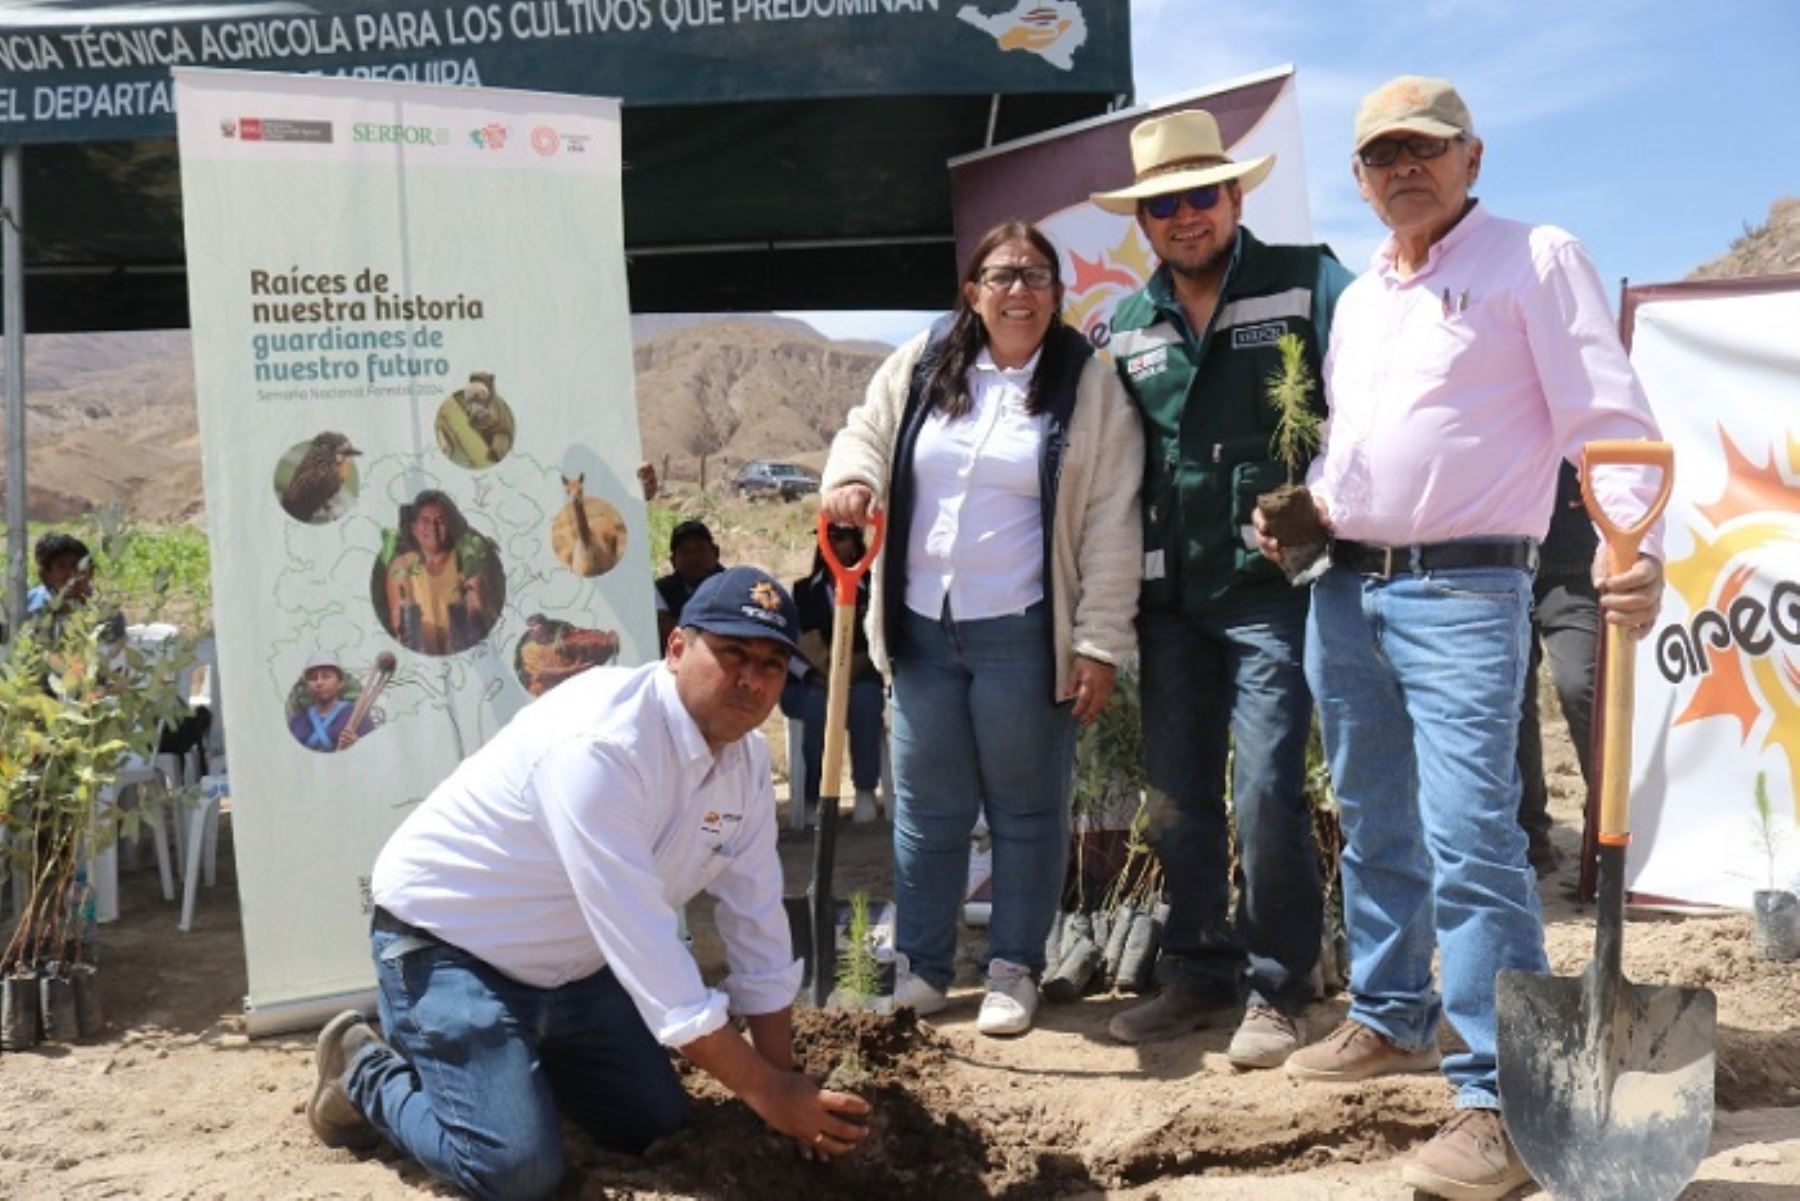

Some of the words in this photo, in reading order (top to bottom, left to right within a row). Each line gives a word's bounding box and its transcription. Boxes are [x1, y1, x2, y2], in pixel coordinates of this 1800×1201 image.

[62, 24, 196, 68] TÉCNICA
[202, 16, 353, 61] AGRICOLA
[355, 10, 442, 51] PARA
[446, 4, 502, 45] LOS
[510, 0, 652, 38] CULTIVOS
[660, 0, 725, 32] QUE
[34, 80, 176, 120] DEPARTA
[336, 57, 482, 87] QUIPA
[353, 122, 434, 146] SERFOR
[250, 266, 347, 295] Raíces
[355, 267, 389, 294] de
[253, 297, 366, 323] nuestra
[374, 294, 484, 321] historia
[252, 326, 406, 360] guardianes
[413, 326, 444, 348] de
[255, 357, 360, 382] nuestro
[367, 354, 450, 383] futuro
